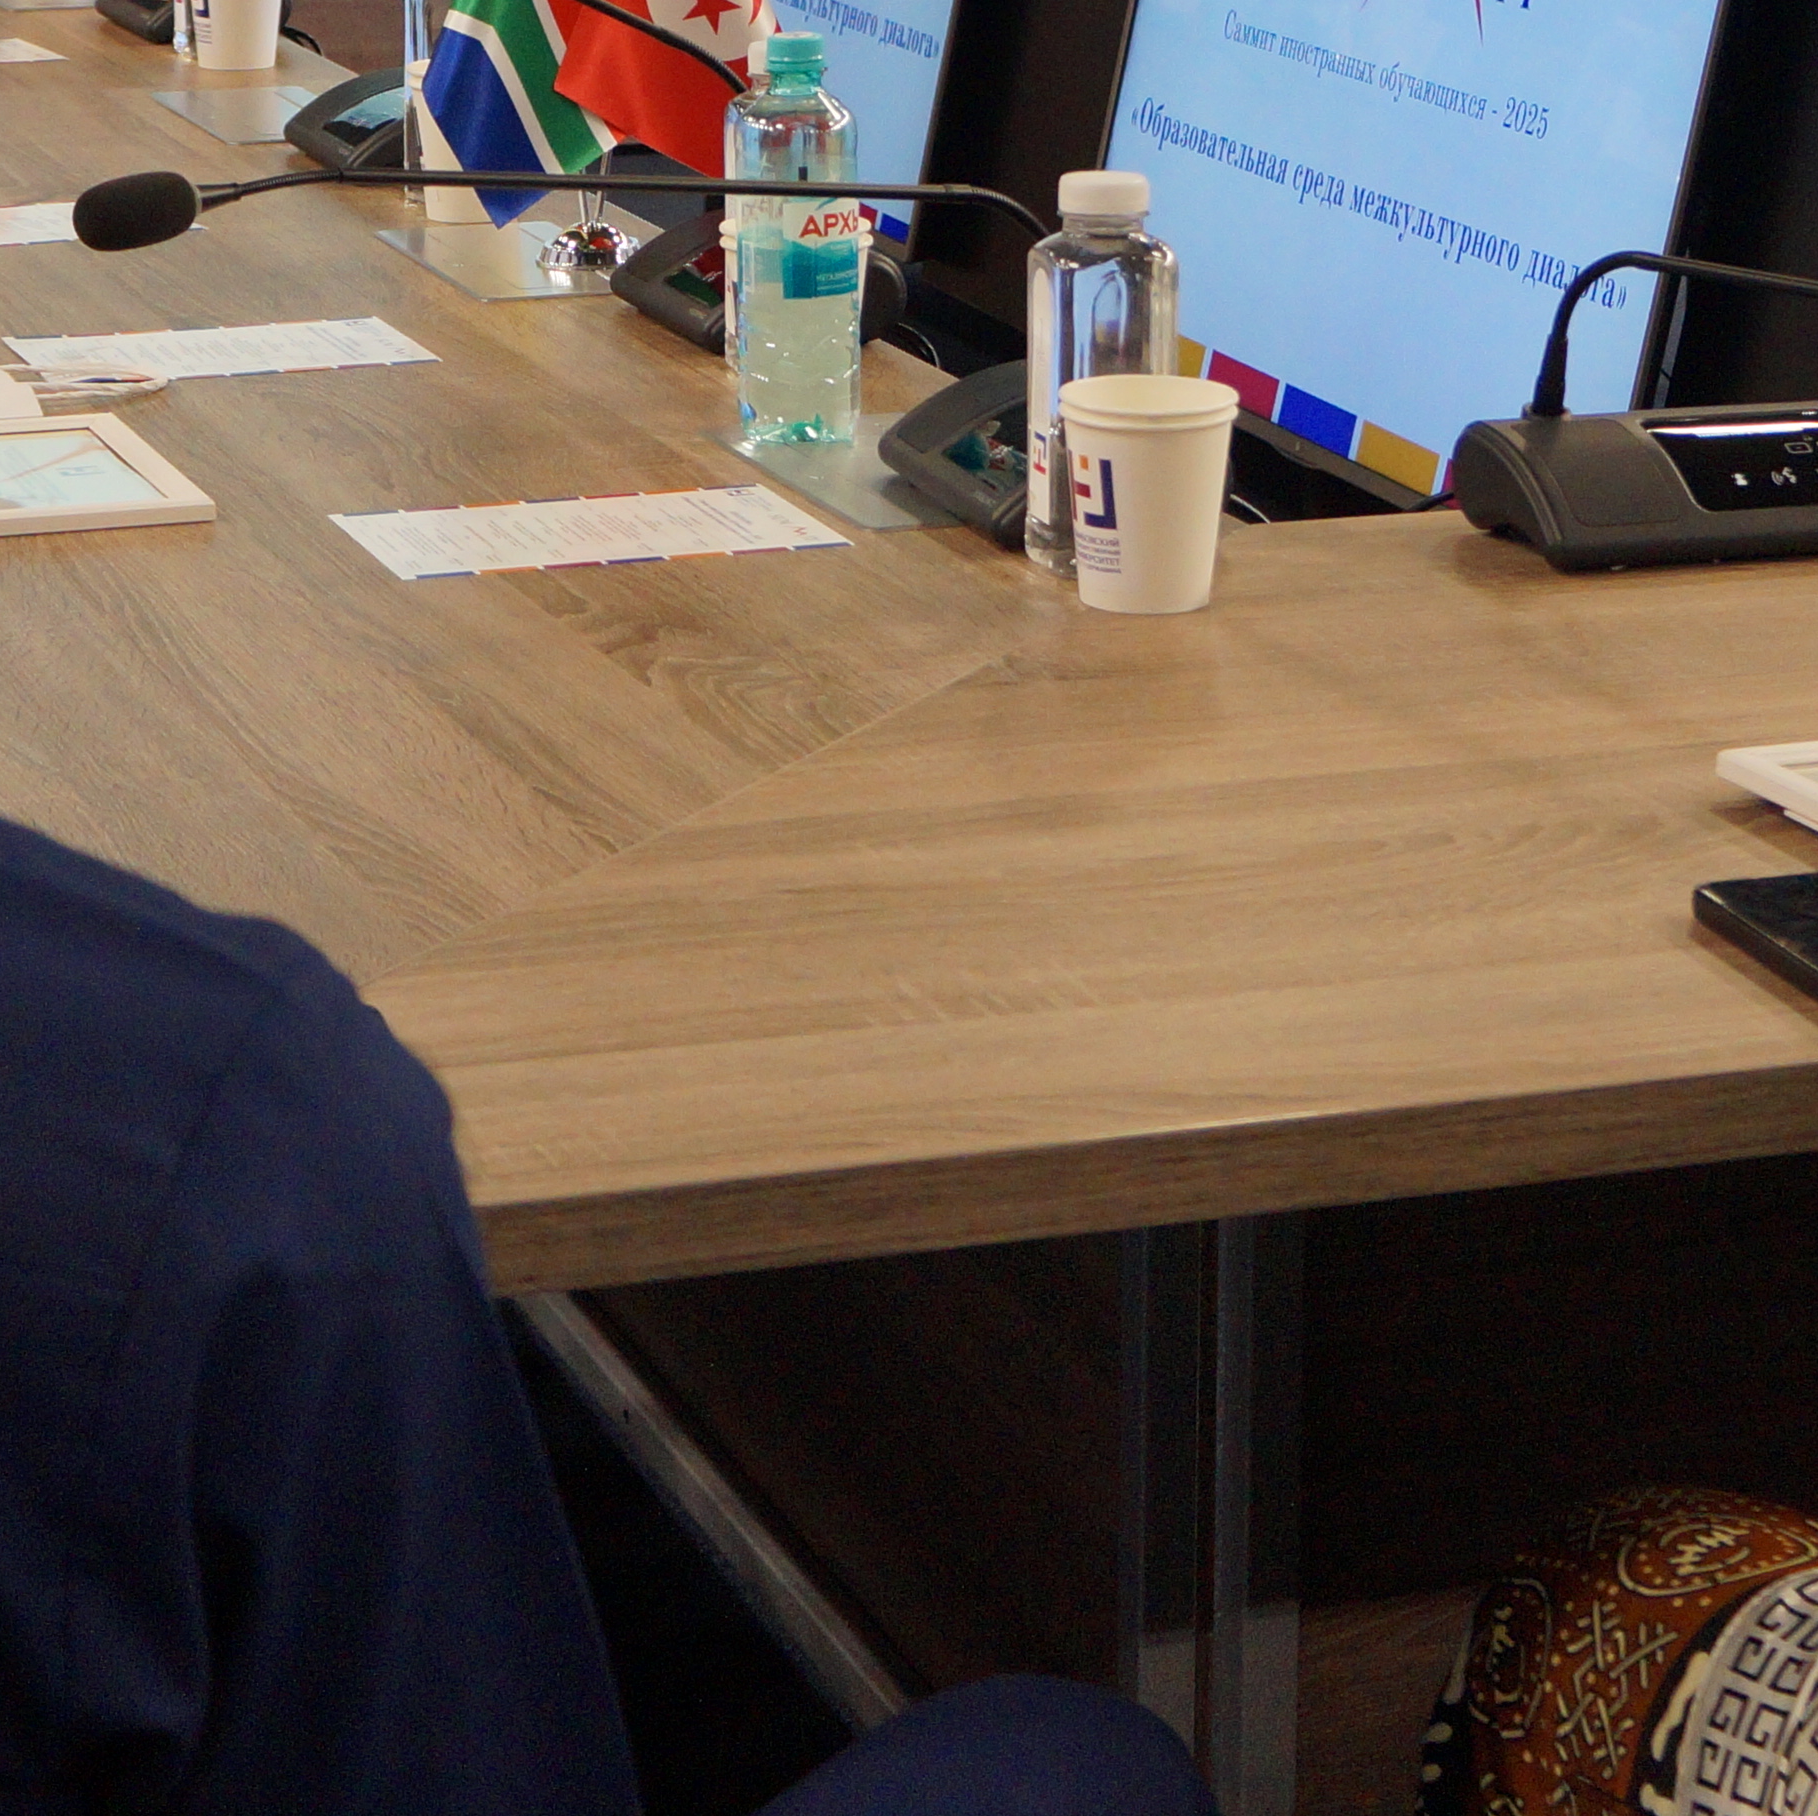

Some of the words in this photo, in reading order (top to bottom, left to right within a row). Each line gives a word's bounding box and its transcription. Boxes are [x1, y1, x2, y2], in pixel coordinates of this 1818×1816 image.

[1224, 9, 1277, 52] Саммит
[1278, 35, 1376, 85] иностранных
[1379, 61, 1487, 115] обучающихся
[1502, 96, 1550, 140] 2025
[1131, 97, 1289, 184] «Образовательная
[1292, 164, 1346, 205] среда
[1349, 184, 1520, 264] межкультурного
